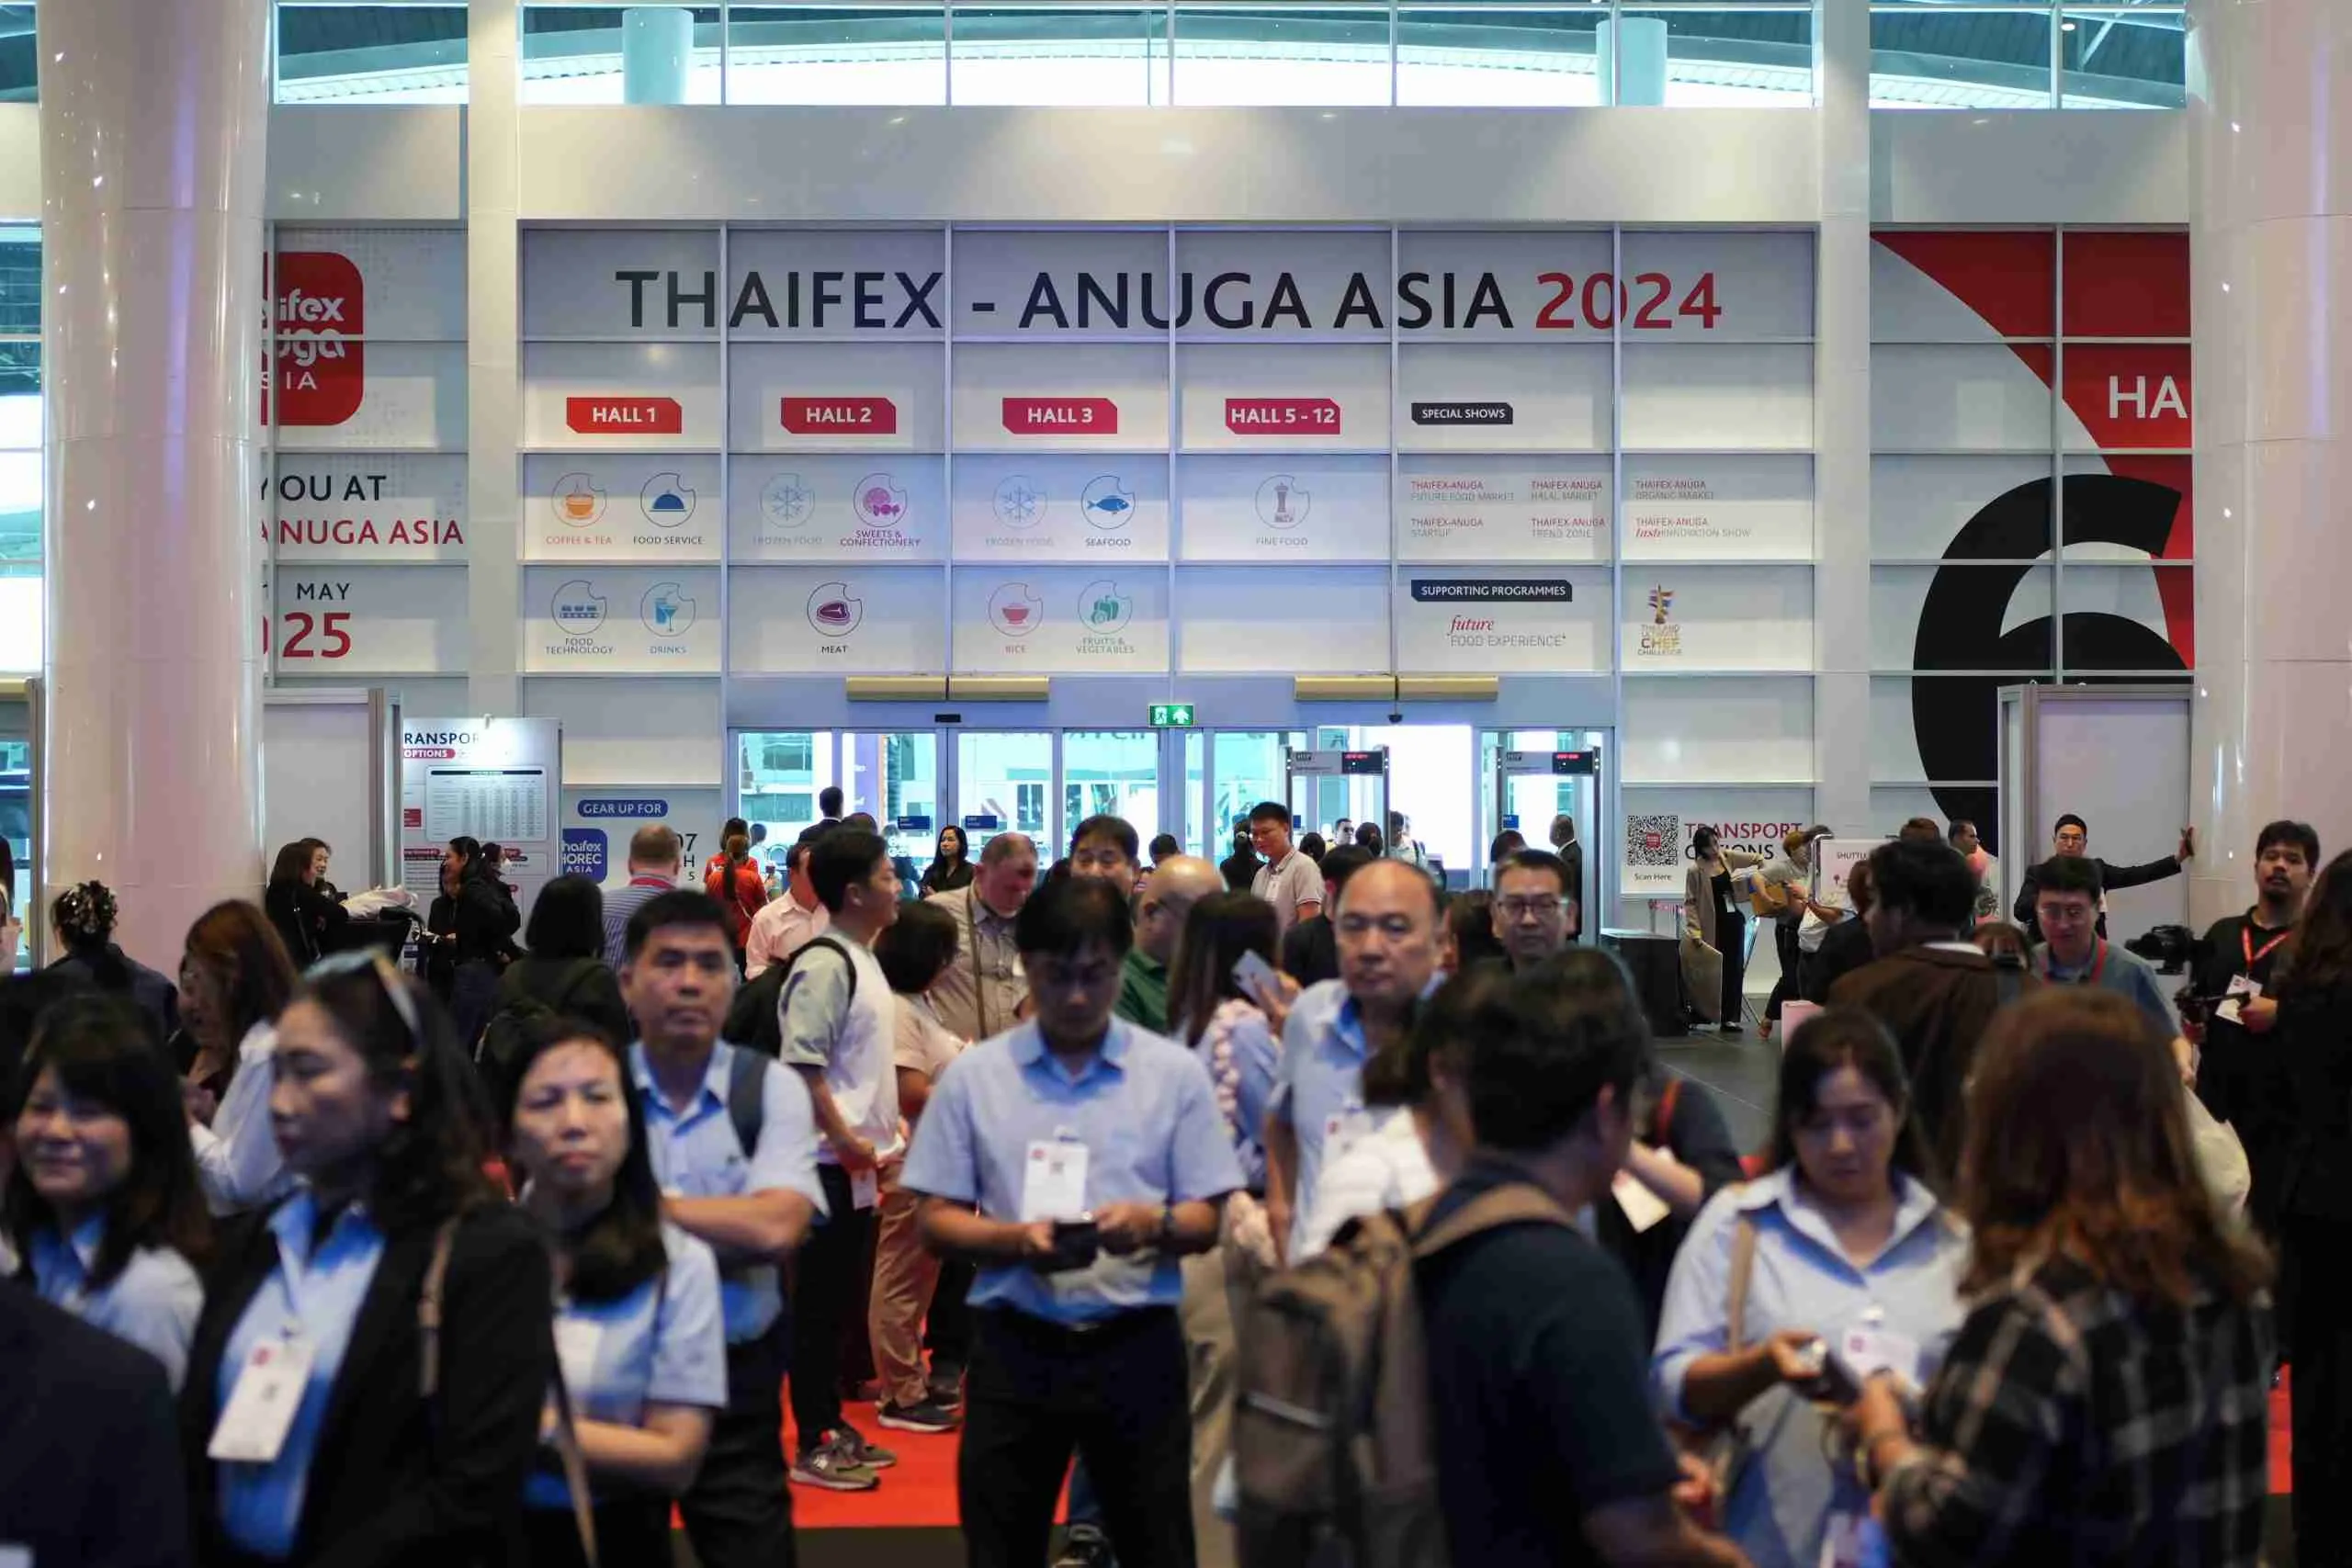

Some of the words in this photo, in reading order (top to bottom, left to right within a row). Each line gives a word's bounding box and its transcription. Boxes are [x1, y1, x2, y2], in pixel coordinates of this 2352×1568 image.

[262, 288, 345, 321] ifex
[616, 272, 943, 328] THAIFEX
[972, 302, 995, 311] -
[1018, 272, 1311, 329] ANUGA
[1333, 272, 1514, 329] ASIA
[1535, 272, 1722, 329] 2024
[2109, 376, 2188, 419] HA
[593, 408, 642, 423] HALL
[647, 408, 656, 423] 1
[806, 408, 855, 423] HALL
[860, 408, 872, 423] 2
[1027, 408, 1077, 423] HALL
[1081, 408, 1093, 423] 3
[1231, 409, 1281, 423] HALL
[1285, 409, 1296, 423] 5
[1313, 409, 1336, 423] 12
[1422, 409, 1463, 419] SPECIAL
[1464, 409, 1506, 419] SHOWS
[343, 475, 387, 502] AT
[1411, 480, 1484, 491] THAIFEX-ANUGA
[1531, 480, 1602, 491] THAIFEX-ANUGA
[1635, 480, 1706, 490] THAIFEX-ANUGA
[1477, 491, 1515, 502] MARKET
[1561, 491, 1599, 502] MARKET
[1679, 491, 1714, 500] MARKET
[1411, 517, 1484, 527] THAIFEX-ANUGA
[1532, 517, 1606, 527] THAIFEX-ANUGA
[1635, 517, 1709, 526] THAIFEX-ANUGA
[388, 519, 464, 545] ASIA
[856, 530, 893, 538] SWEETS
[1722, 528, 1751, 537] SHOW
[546, 536, 582, 546] COFFEE
[595, 536, 613, 546] TEA
[633, 536, 662, 546] FOOD
[664, 536, 705, 546] SERVICE
[840, 537, 922, 547] CONFECTIONERY
[1085, 538, 1132, 547] SEAFOOD
[1279, 536, 1308, 546] FOOD
[297, 583, 350, 601] MAY
[1421, 586, 1489, 596] SUPPORTING
[1491, 586, 1566, 596] PROGRAMMES
[1451, 615, 1495, 634] future
[566, 637, 594, 646] FOOD
[1083, 637, 1116, 646] FRUITS
[1451, 635, 1485, 647] FOOD
[546, 646, 614, 655] TECHNOLOGY
[650, 646, 687, 654] DRINKS
[821, 646, 848, 654] MEAT
[1005, 646, 1027, 654] RICE
[1076, 646, 1136, 654] VEGETABLES
[404, 749, 448, 759] OPTIONS
[582, 803, 616, 815] GEAR
[619, 803, 634, 815] UP
[638, 803, 662, 815] FOR
[1685, 823, 1803, 839] TANSPORT
[1634, 874, 1653, 882] Scan
[1654, 874, 1672, 882] Here
